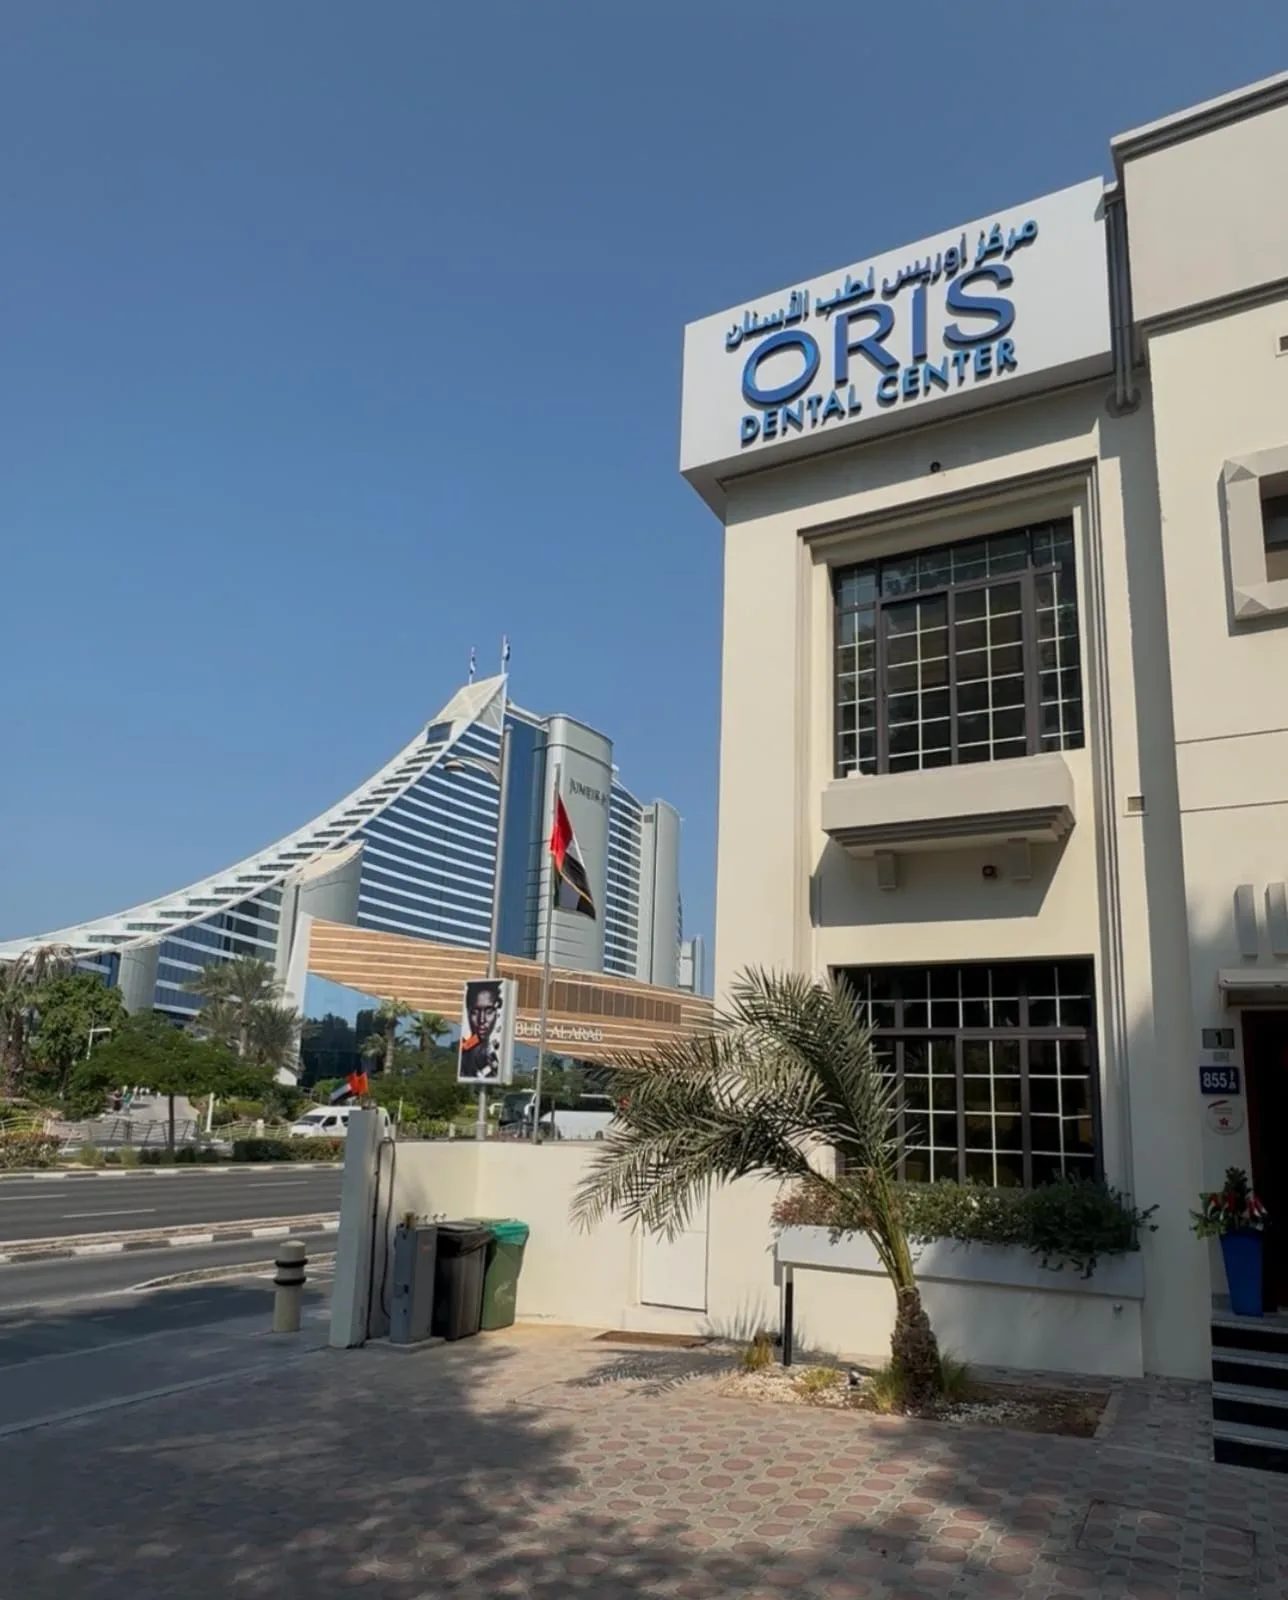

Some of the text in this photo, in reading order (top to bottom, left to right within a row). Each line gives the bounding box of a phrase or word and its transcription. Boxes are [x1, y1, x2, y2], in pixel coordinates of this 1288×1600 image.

[974, 220, 1038, 267] مركز
[816, 266, 875, 319] لطب
[741, 264, 1015, 405] ORIS
[741, 338, 1017, 446] DENTAL CENTER
[514, 1021, 544, 1037] BUR
[1203, 1071, 1228, 1089] 855
